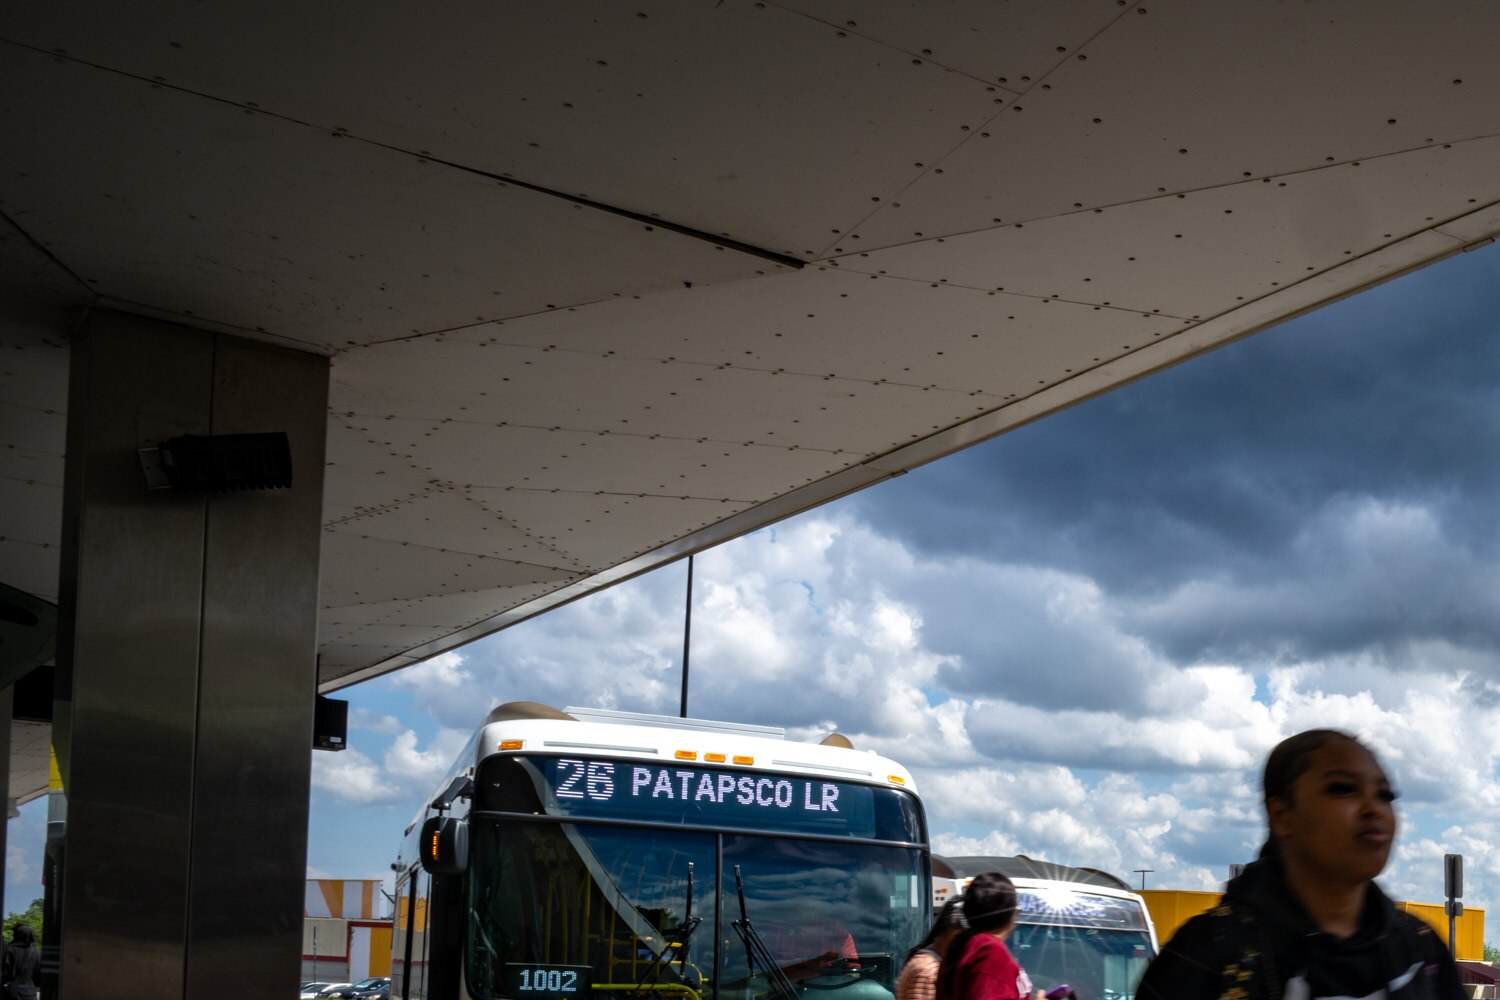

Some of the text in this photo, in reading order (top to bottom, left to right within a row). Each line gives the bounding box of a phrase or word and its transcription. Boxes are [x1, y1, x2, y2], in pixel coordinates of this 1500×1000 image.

[556, 759, 839, 812] 26 PATAPSCO LR
[519, 969, 577, 992] 1002
